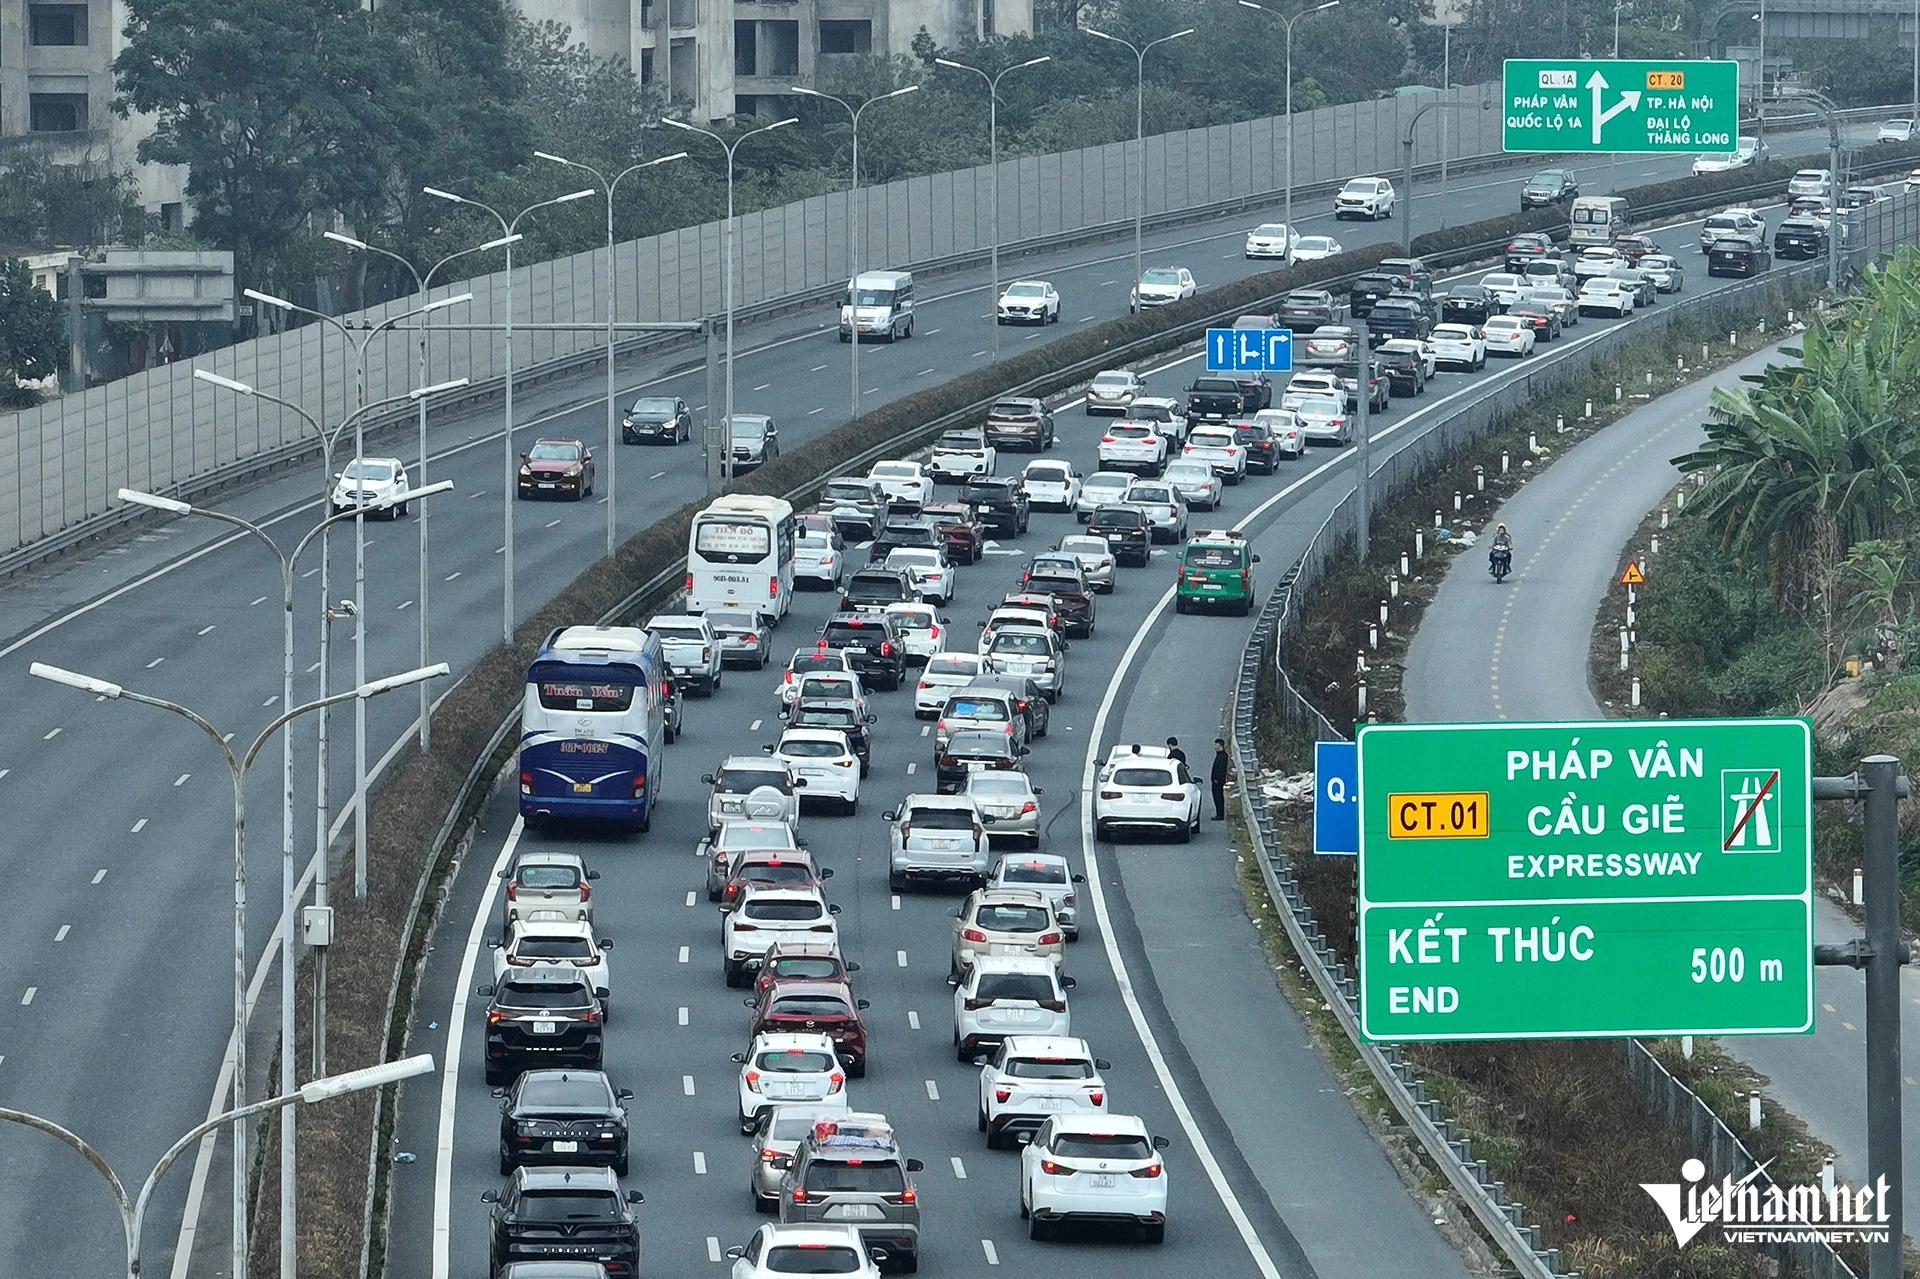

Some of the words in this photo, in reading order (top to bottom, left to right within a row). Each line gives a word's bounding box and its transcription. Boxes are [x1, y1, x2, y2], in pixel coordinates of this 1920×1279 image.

[1541, 73, 1574, 85] QL.1A
[1649, 74, 1683, 86] CT.20
[1513, 93, 1548, 109] PHÁP
[1553, 93, 1578, 109] VÂN
[1691, 94, 1714, 112] NỘI
[1506, 112, 1543, 129] QUỐC
[1546, 113, 1564, 131] LỘ
[1567, 116, 1583, 129] 1A
[1646, 117, 1670, 133] ĐẠI
[1673, 114, 1692, 132] LỘ
[1646, 128, 1692, 145] THĂNG
[1695, 132, 1730, 145] LONG
[1507, 737, 1613, 781] PHÁP
[1628, 739, 1704, 779] VÂN
[1400, 801, 1478, 831] CT.01
[1527, 791, 1606, 837] CẦU
[1622, 794, 1686, 835] GIẼ
[1508, 851, 1703, 879] EXPRESSWAY
[1388, 912, 1468, 964] KẾT
[1487, 916, 1595, 963] THÚC
[1691, 947, 1746, 983] 500
[1759, 957, 1784, 982] m
[1389, 986, 1460, 1014] END
